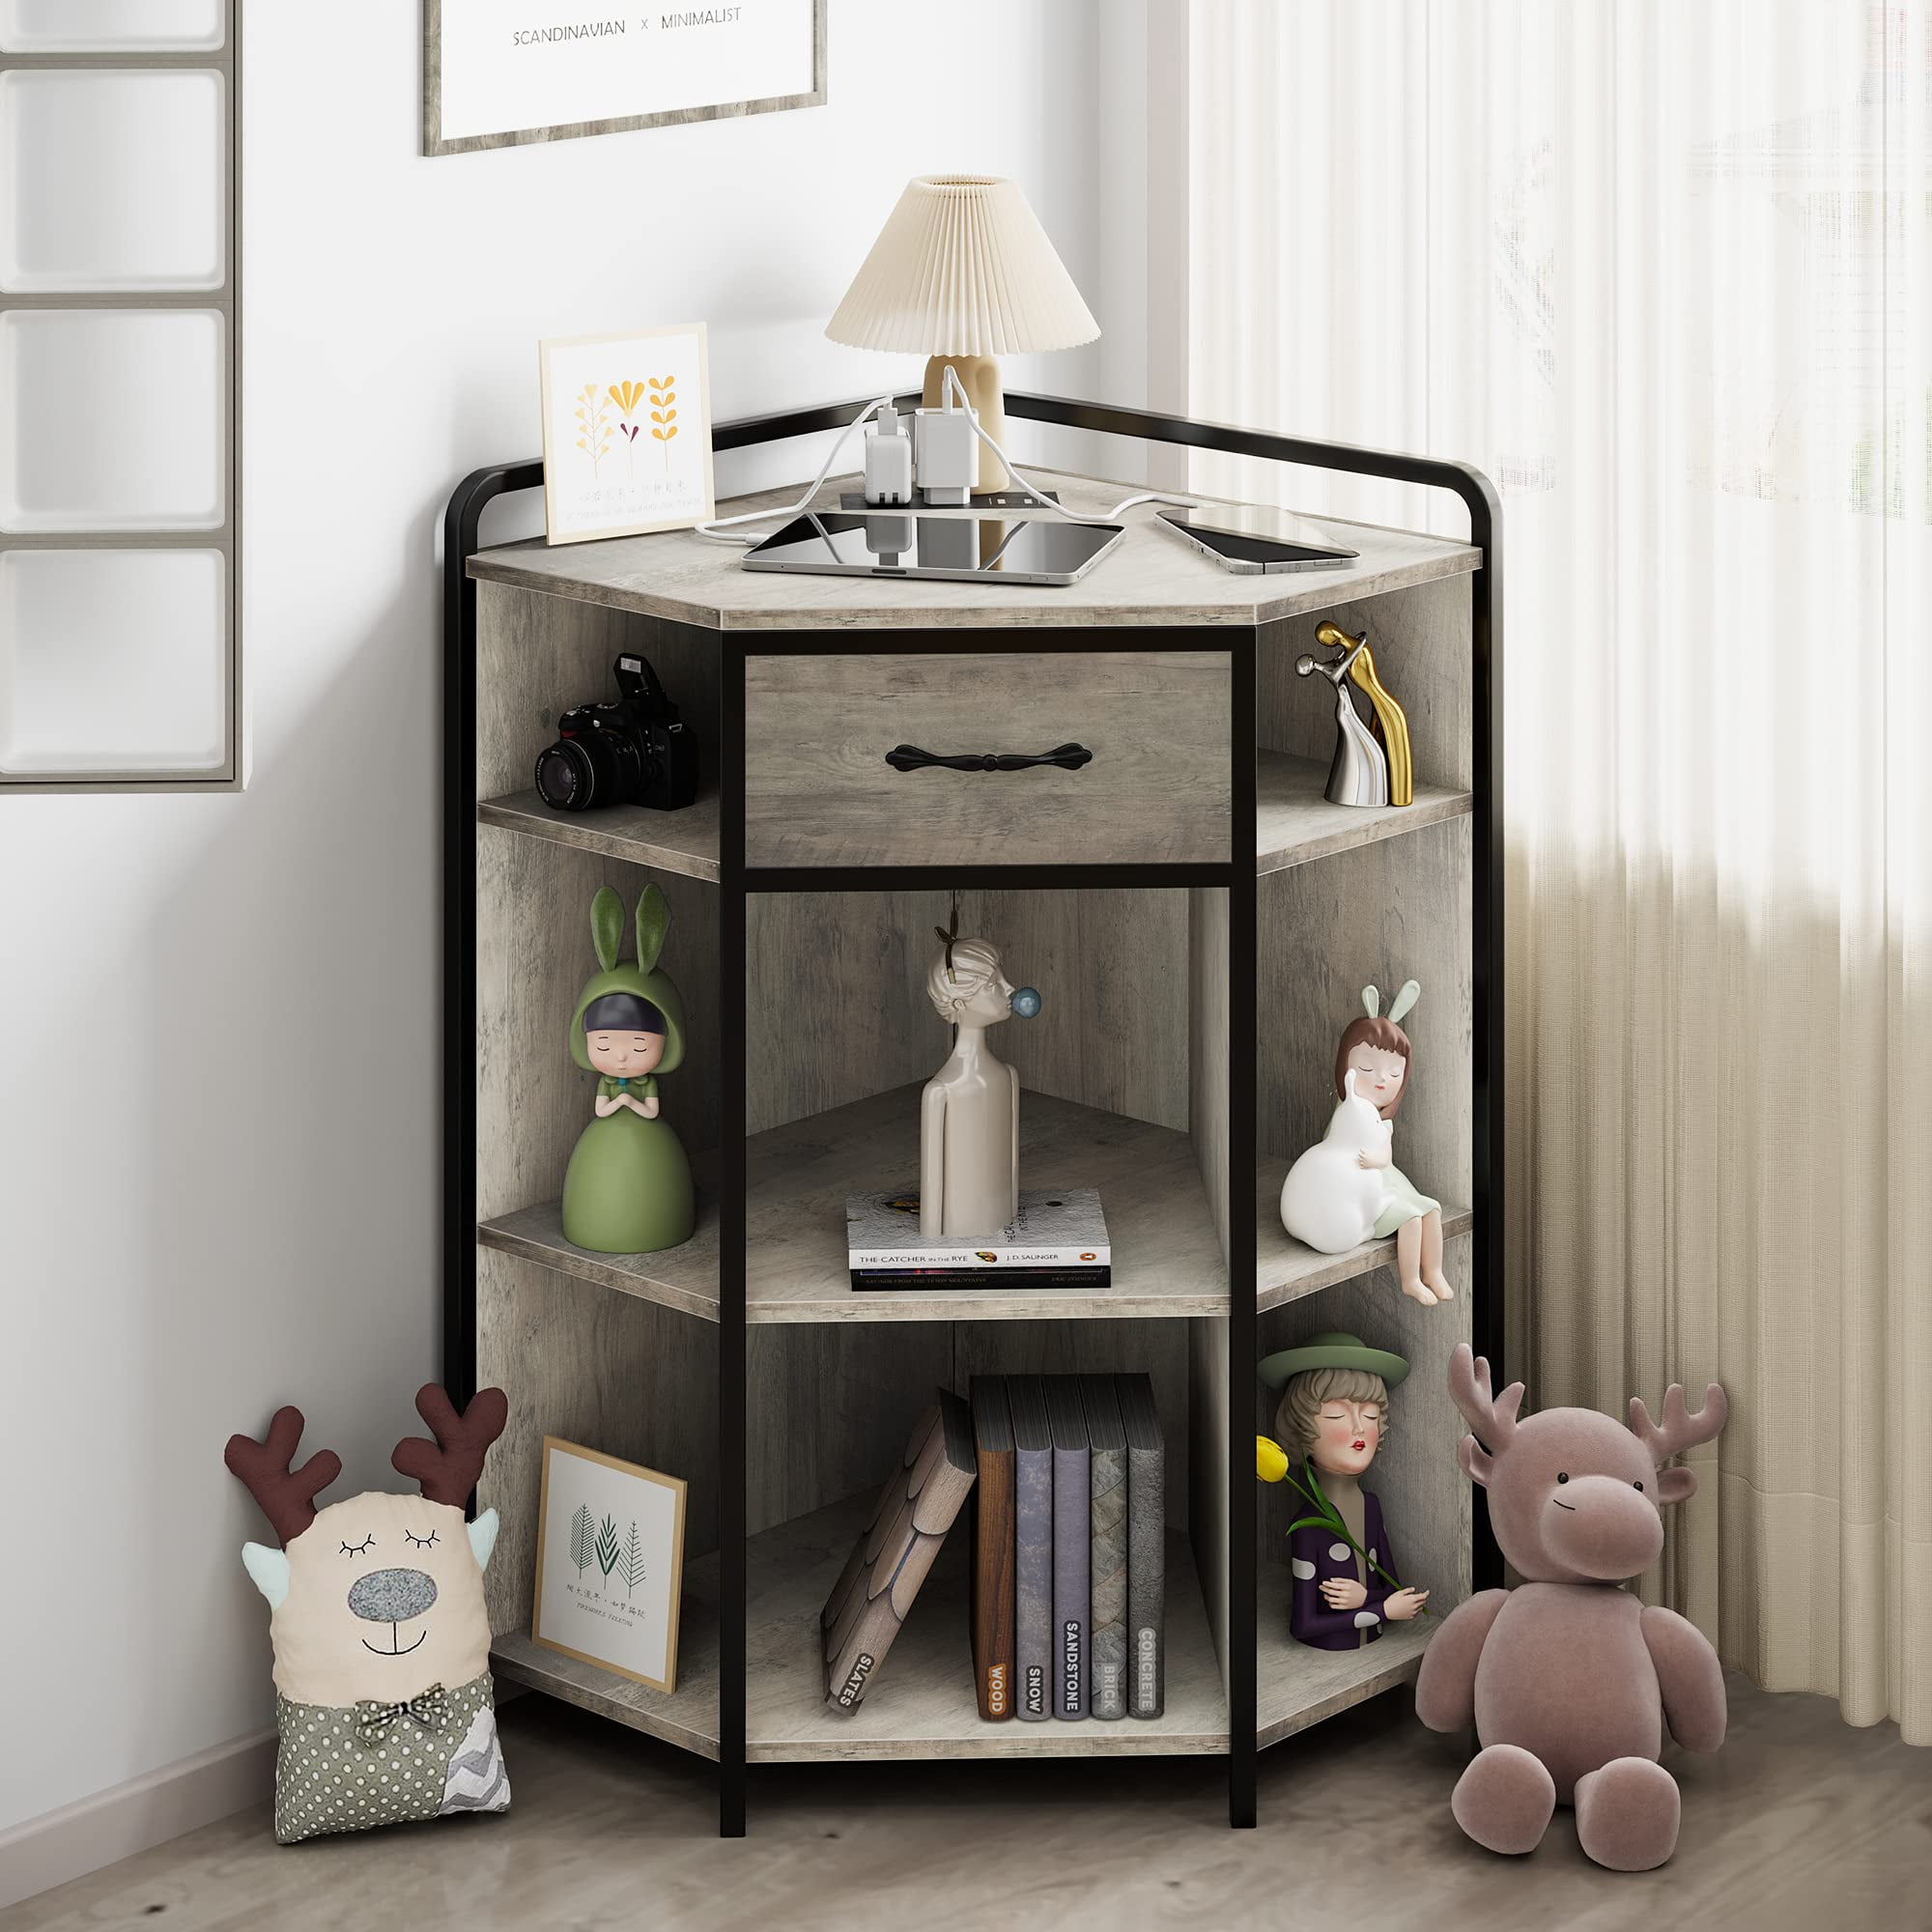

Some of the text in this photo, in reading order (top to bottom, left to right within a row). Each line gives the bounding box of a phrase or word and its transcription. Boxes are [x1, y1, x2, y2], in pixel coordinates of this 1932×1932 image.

[513, 19, 625, 45] SCANDINAVIAN
[662, 7, 741, 30] MINIMALIST
[839, 1655, 872, 1707] SLATES
[990, 1666, 1004, 1713] WOOD
[1065, 1622, 1079, 1711] SANDSTONE
[1103, 1665, 1116, 1710] BRICK
[1140, 1630, 1153, 1709] CONCRETE
[1029, 1668, 1041, 1713] SNOW
